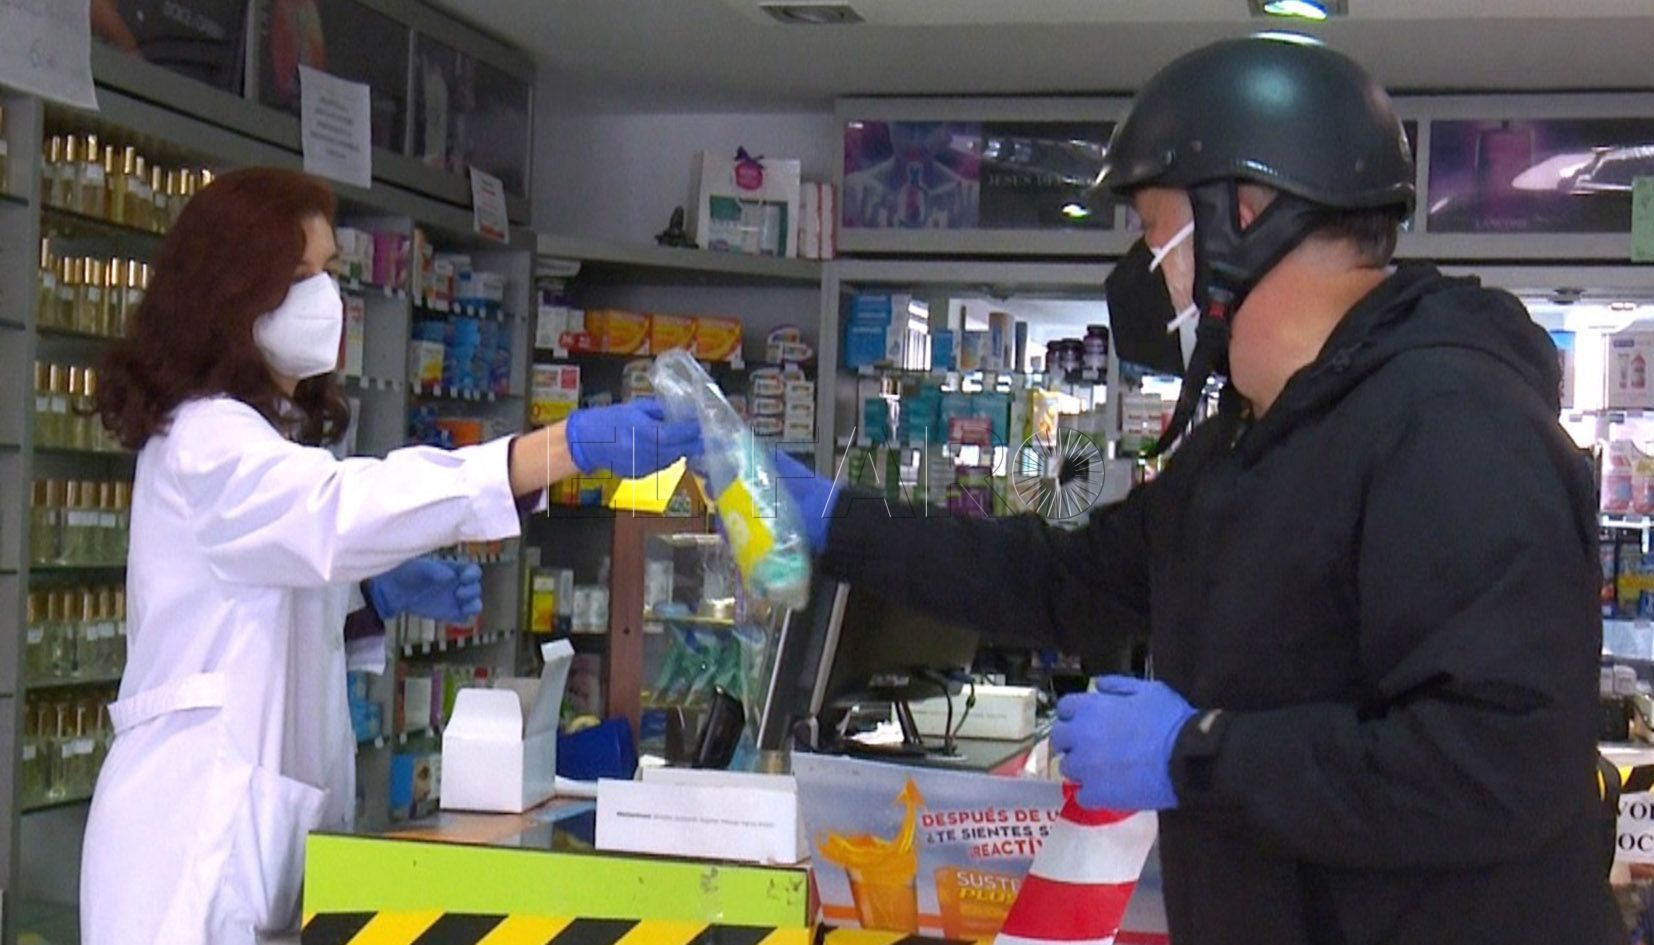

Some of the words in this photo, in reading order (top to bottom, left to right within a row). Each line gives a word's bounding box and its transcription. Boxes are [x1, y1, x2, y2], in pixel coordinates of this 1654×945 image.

[922, 805, 1008, 828] DESPUÉS
[1015, 809, 1040, 822] DE
[961, 825, 1033, 841] SIENTES
[1038, 825, 1054, 837] S
